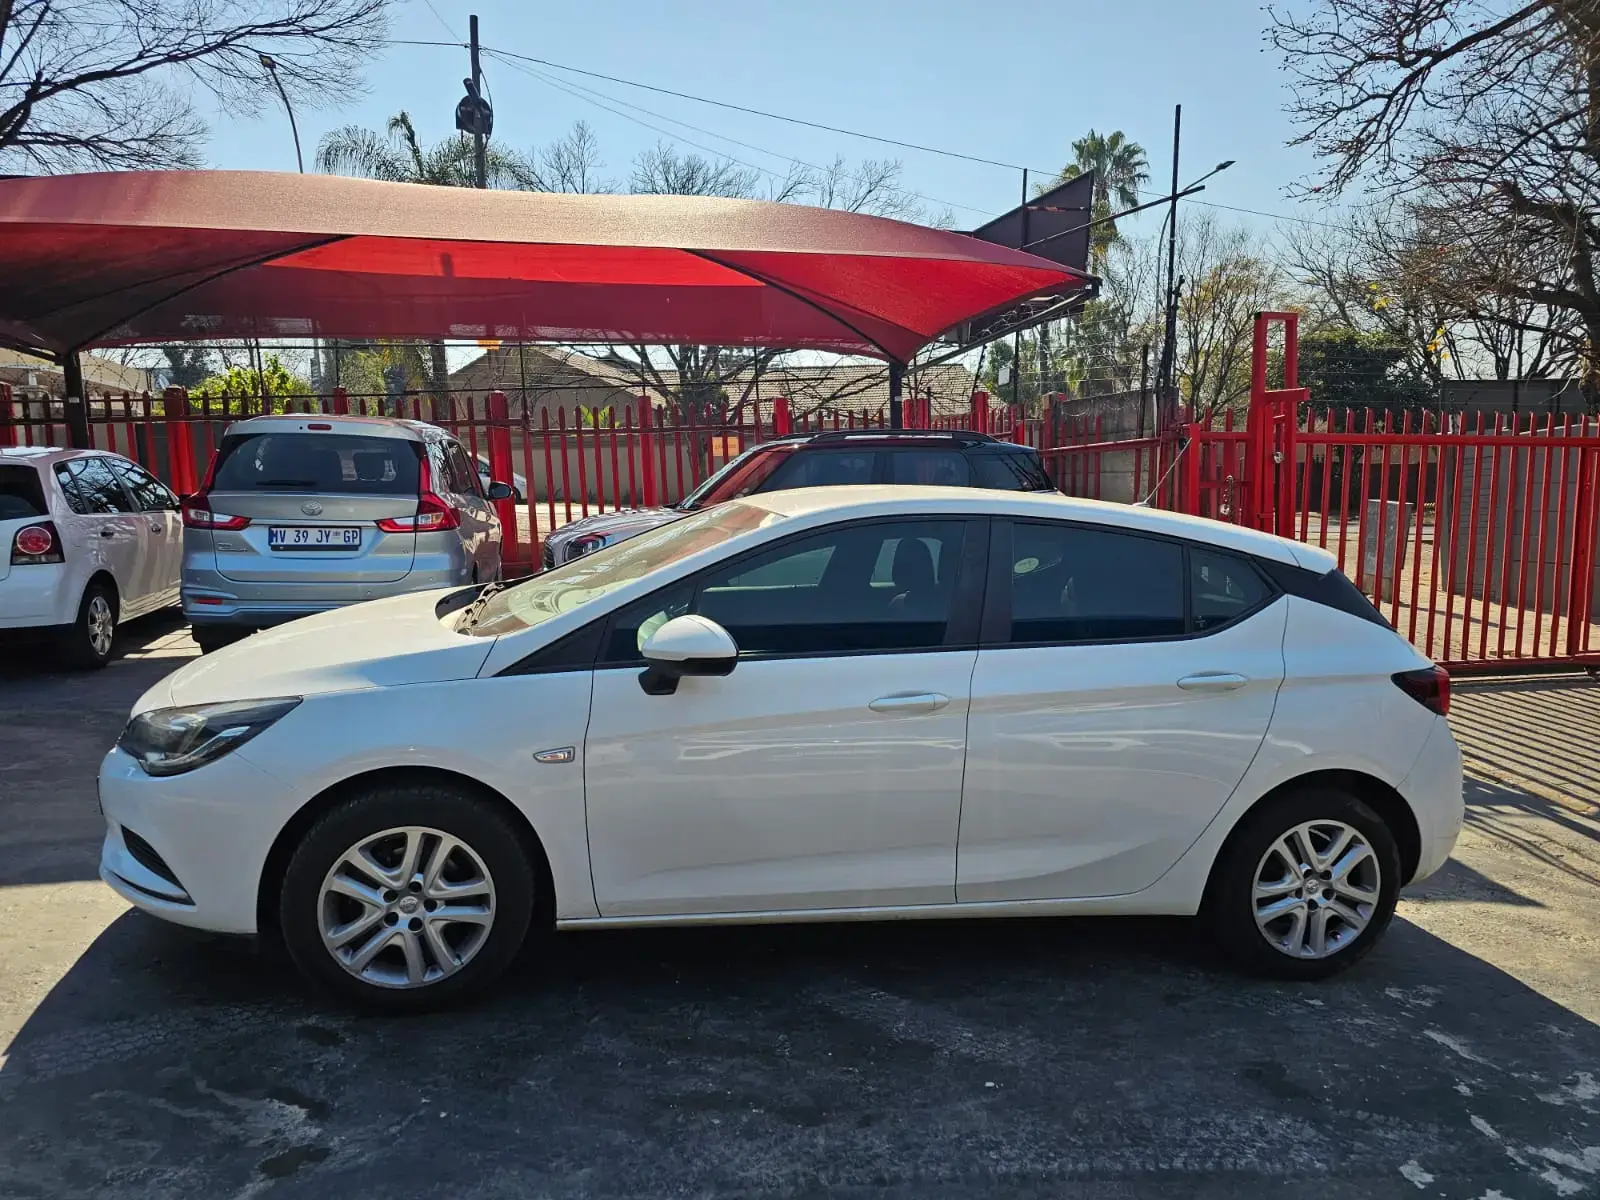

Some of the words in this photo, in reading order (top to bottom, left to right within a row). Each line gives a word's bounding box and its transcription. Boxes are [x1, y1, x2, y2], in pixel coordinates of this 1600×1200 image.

[294, 529, 309, 543] 39
[316, 529, 331, 543] JY
[343, 529, 359, 544] GP
